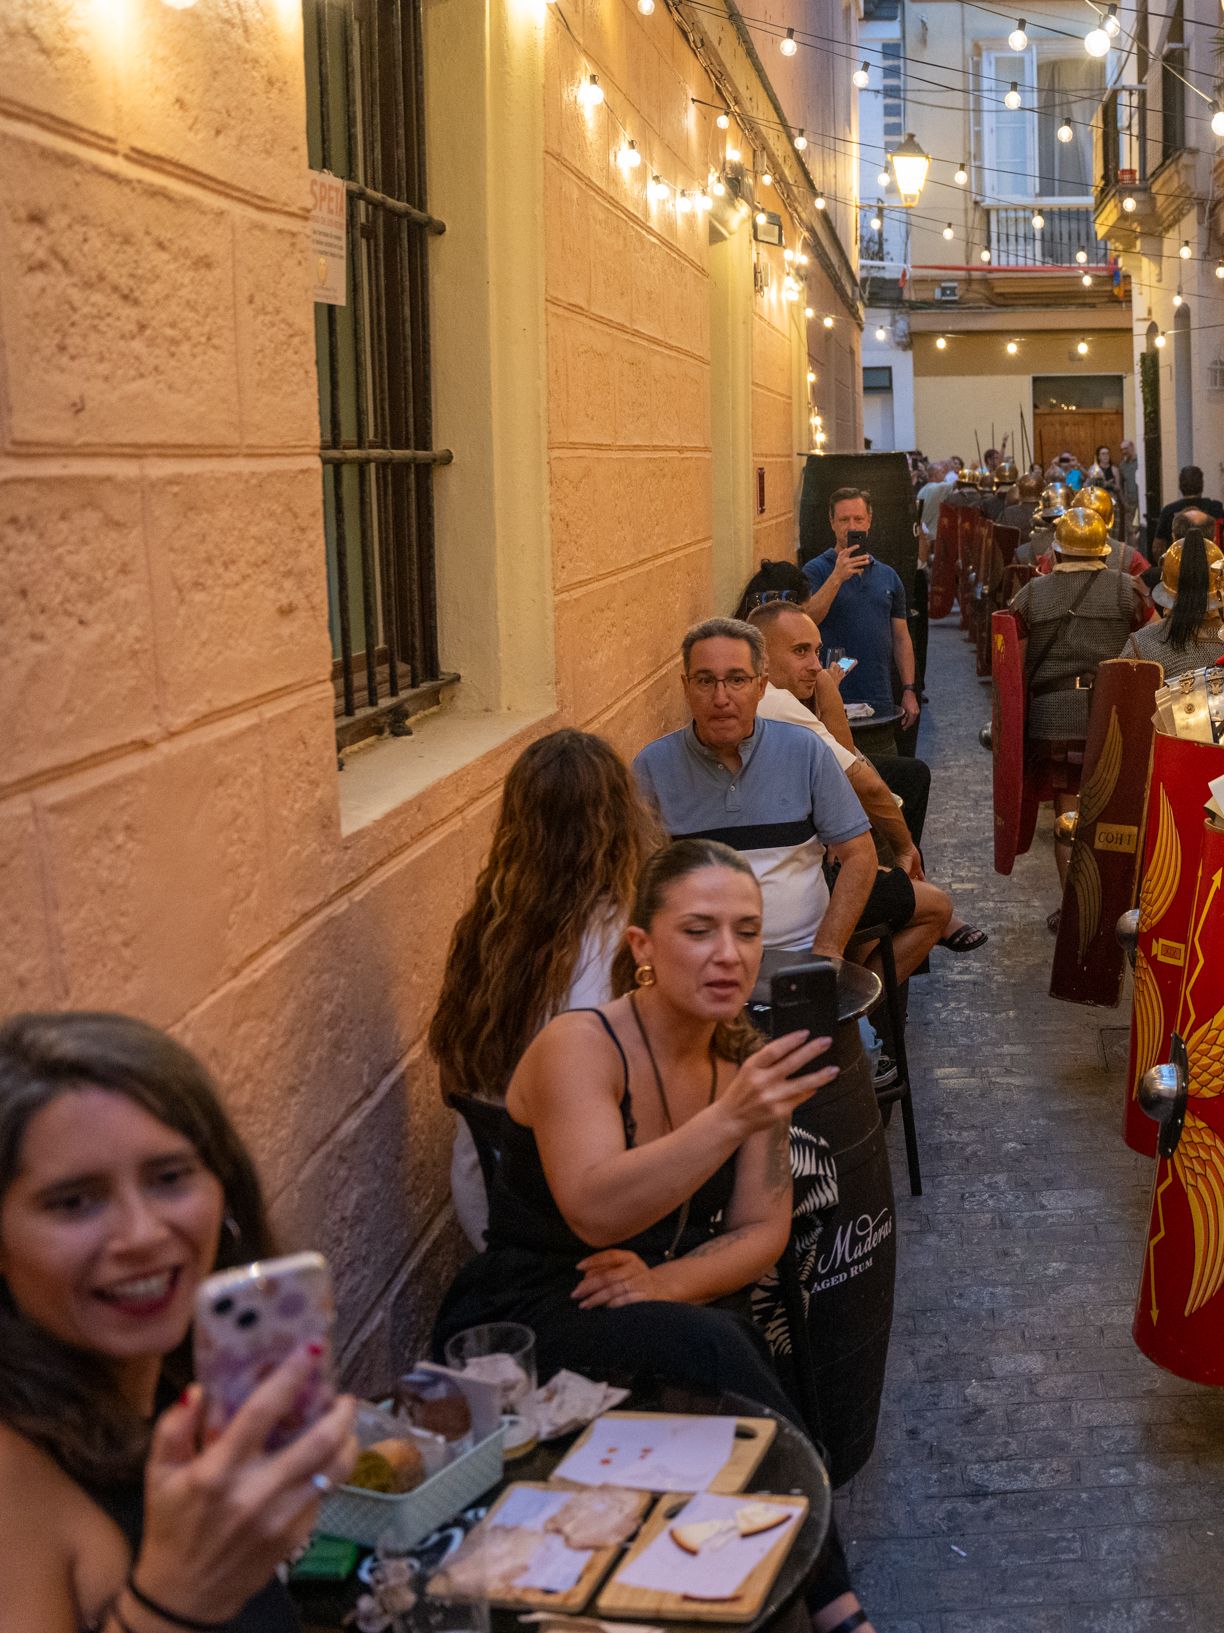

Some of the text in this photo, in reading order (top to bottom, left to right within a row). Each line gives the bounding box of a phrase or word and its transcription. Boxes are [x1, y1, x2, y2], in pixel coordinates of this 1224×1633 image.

[817, 1207, 892, 1274] Maderas
[811, 1258, 873, 1293] AGED RUM
